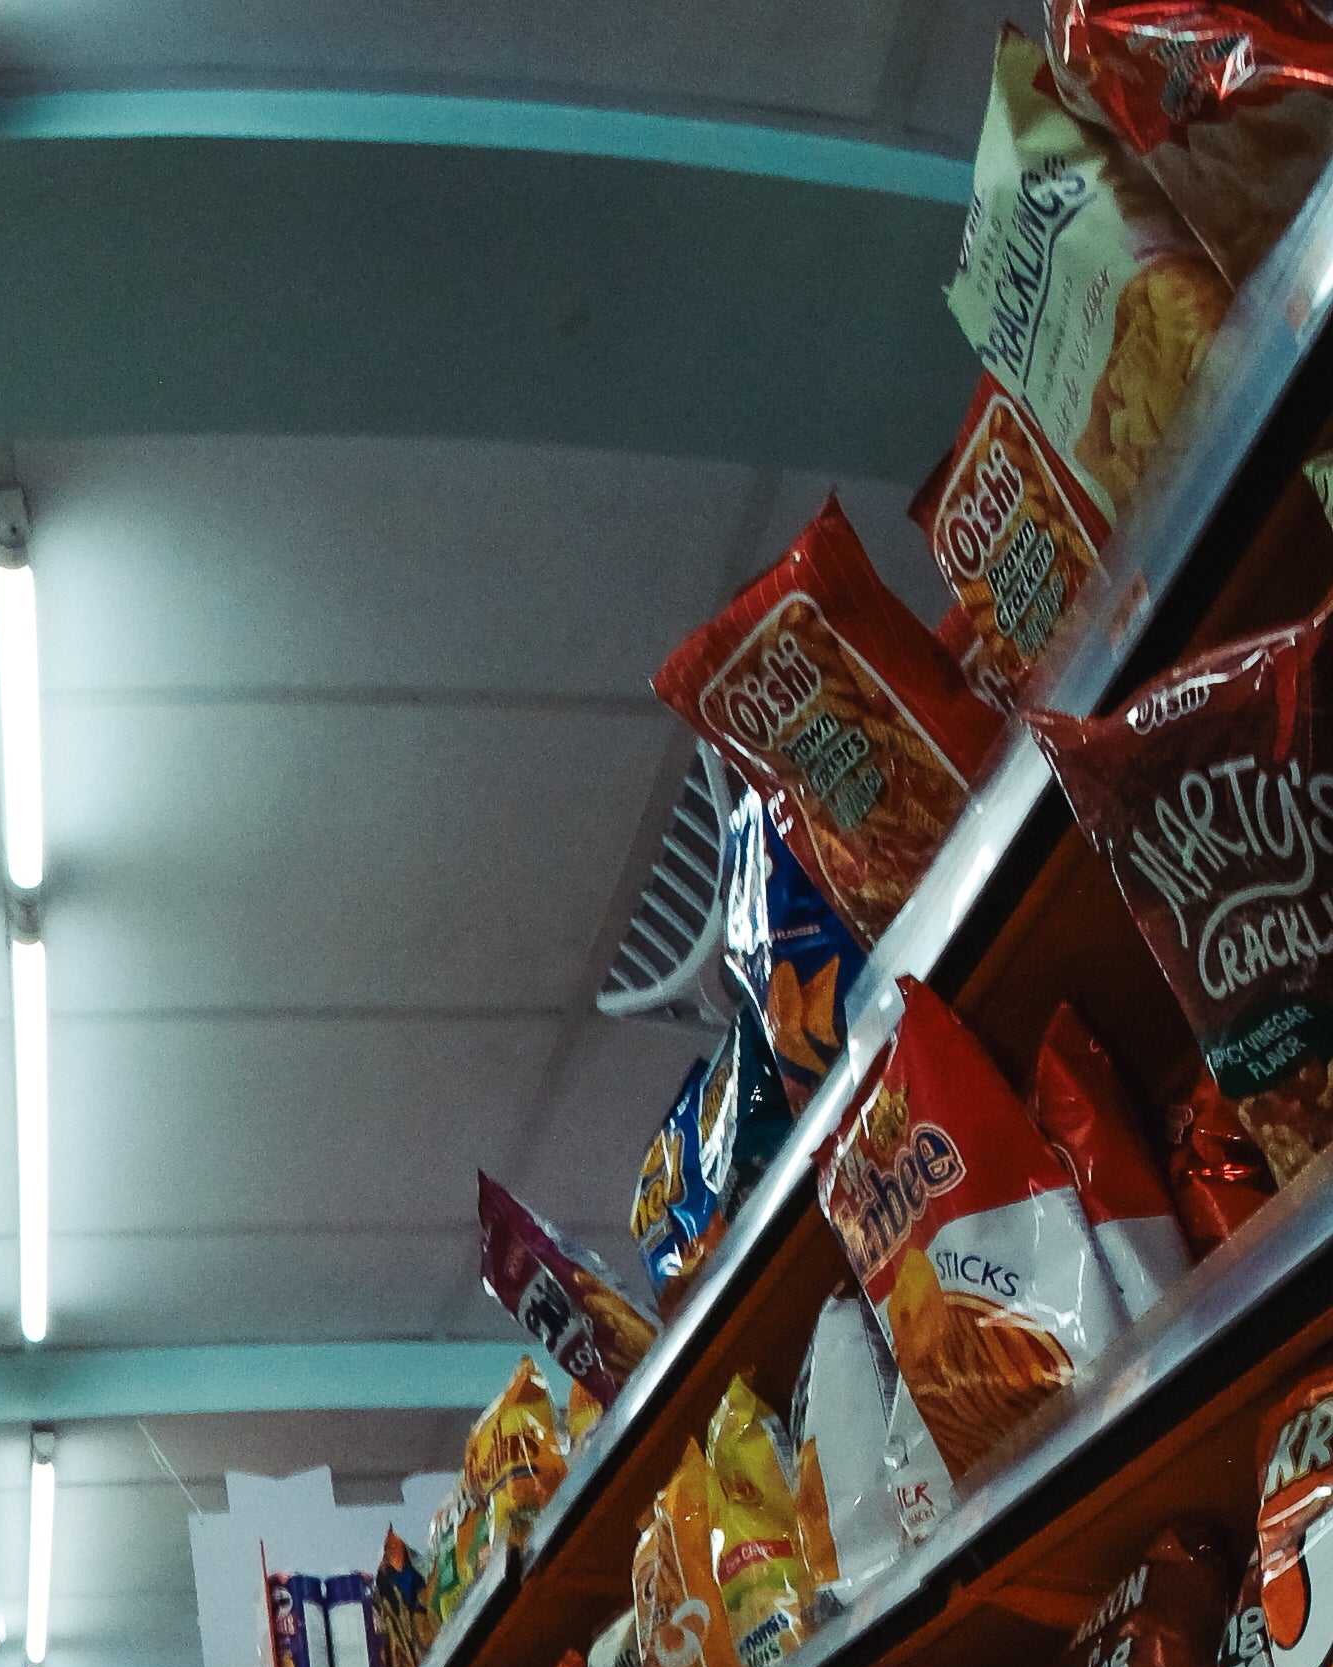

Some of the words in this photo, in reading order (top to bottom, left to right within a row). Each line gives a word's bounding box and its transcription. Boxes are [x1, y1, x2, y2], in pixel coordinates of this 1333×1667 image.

[946, 440, 1023, 580] Oishi
[988, 518, 1036, 597] Prawn
[728, 631, 821, 751] Oishi
[1243, 1004, 1314, 1054] VINEGAR
[1250, 1035, 1306, 1081] FLAVOR
[934, 1251, 1020, 1298] STICKS
